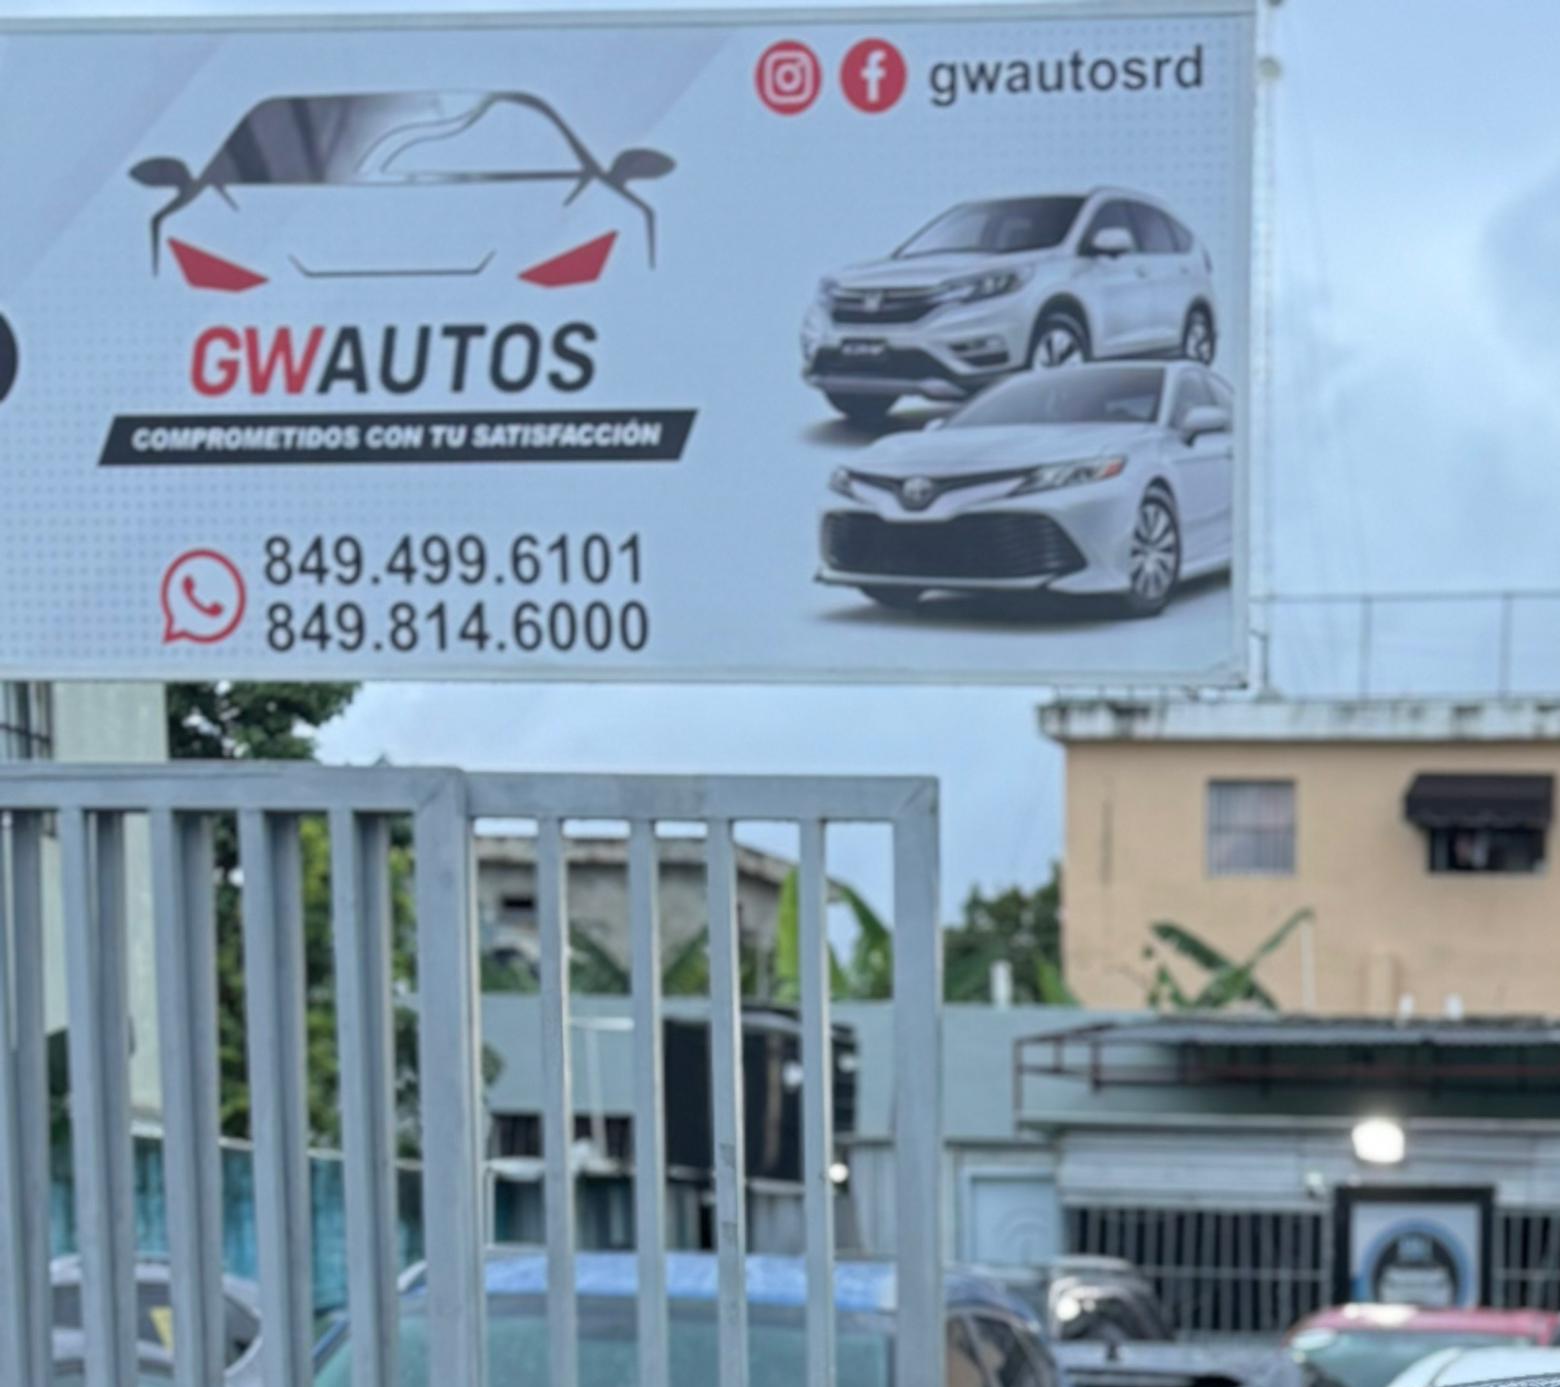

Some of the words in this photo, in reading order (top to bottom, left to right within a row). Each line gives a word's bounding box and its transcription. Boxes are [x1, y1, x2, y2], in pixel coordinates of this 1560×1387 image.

[929, 44, 1203, 108] gwautosrd
[190, 321, 598, 397] GWAUTOS
[131, 425, 359, 452] COMPROMETIDOS
[365, 424, 423, 450] CON
[429, 423, 467, 449] TU
[472, 418, 662, 449] SATISFACCIÓN
[264, 532, 640, 586] 849.499.6101
[267, 600, 650, 653] 849.814.6000
